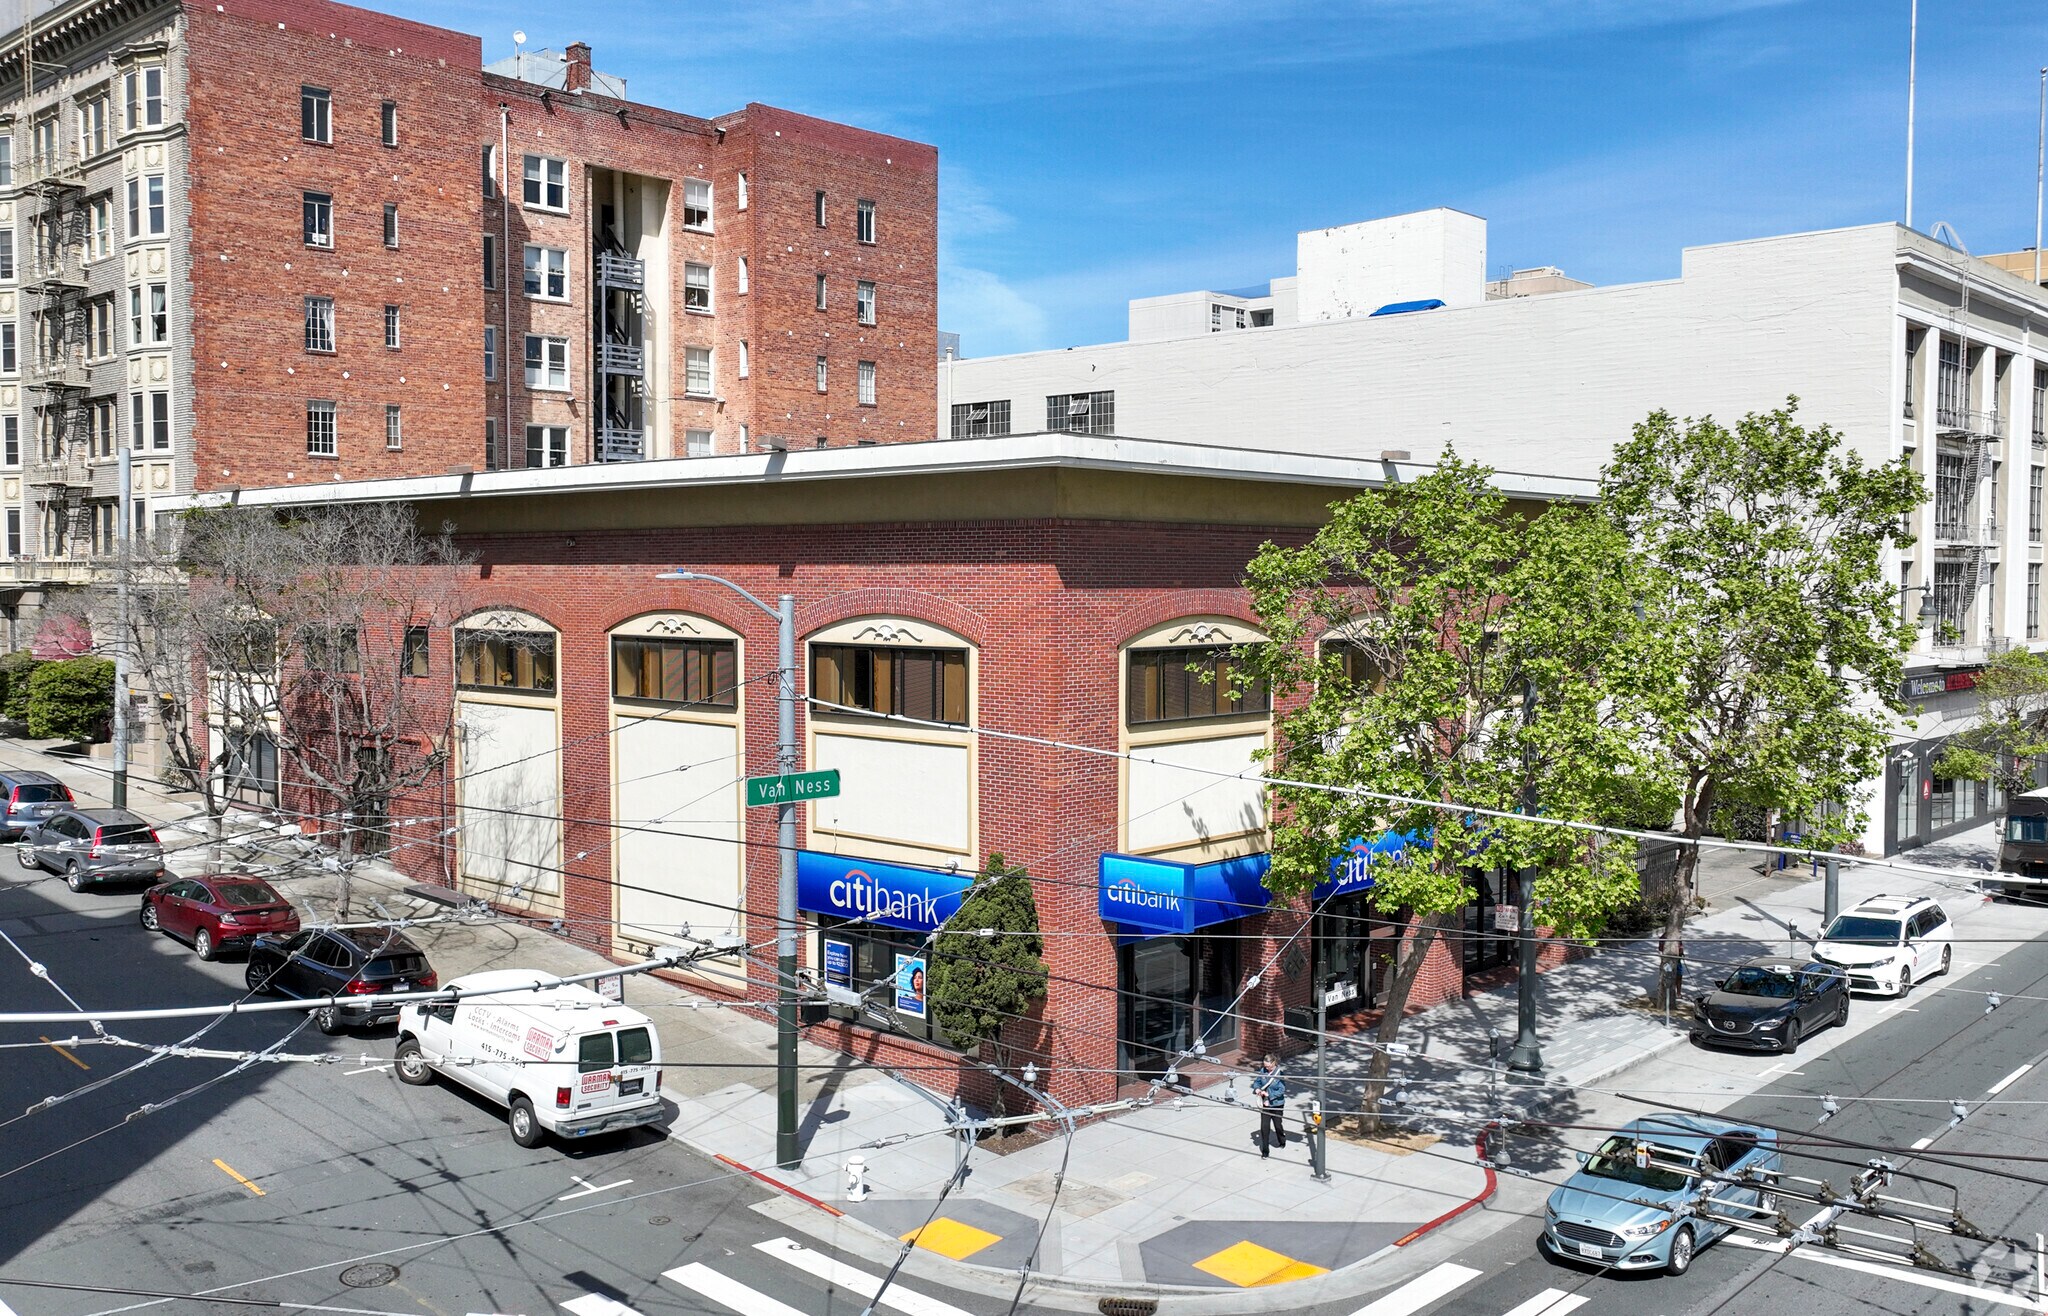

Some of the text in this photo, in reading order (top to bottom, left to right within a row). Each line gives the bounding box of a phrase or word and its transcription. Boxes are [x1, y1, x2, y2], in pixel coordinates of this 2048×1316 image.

[759, 778, 830, 798] Van Ness
[829, 875, 939, 925] citibank
[1107, 880, 1181, 912] citibank
[1328, 989, 1355, 1002] Van Ness
[468, 1011, 521, 1041] Locks Intercoms
[474, 1006, 520, 1031] CCTV Alarms
[525, 1041, 549, 1059] SECURITY
[584, 1082, 609, 1092] SECURITY
